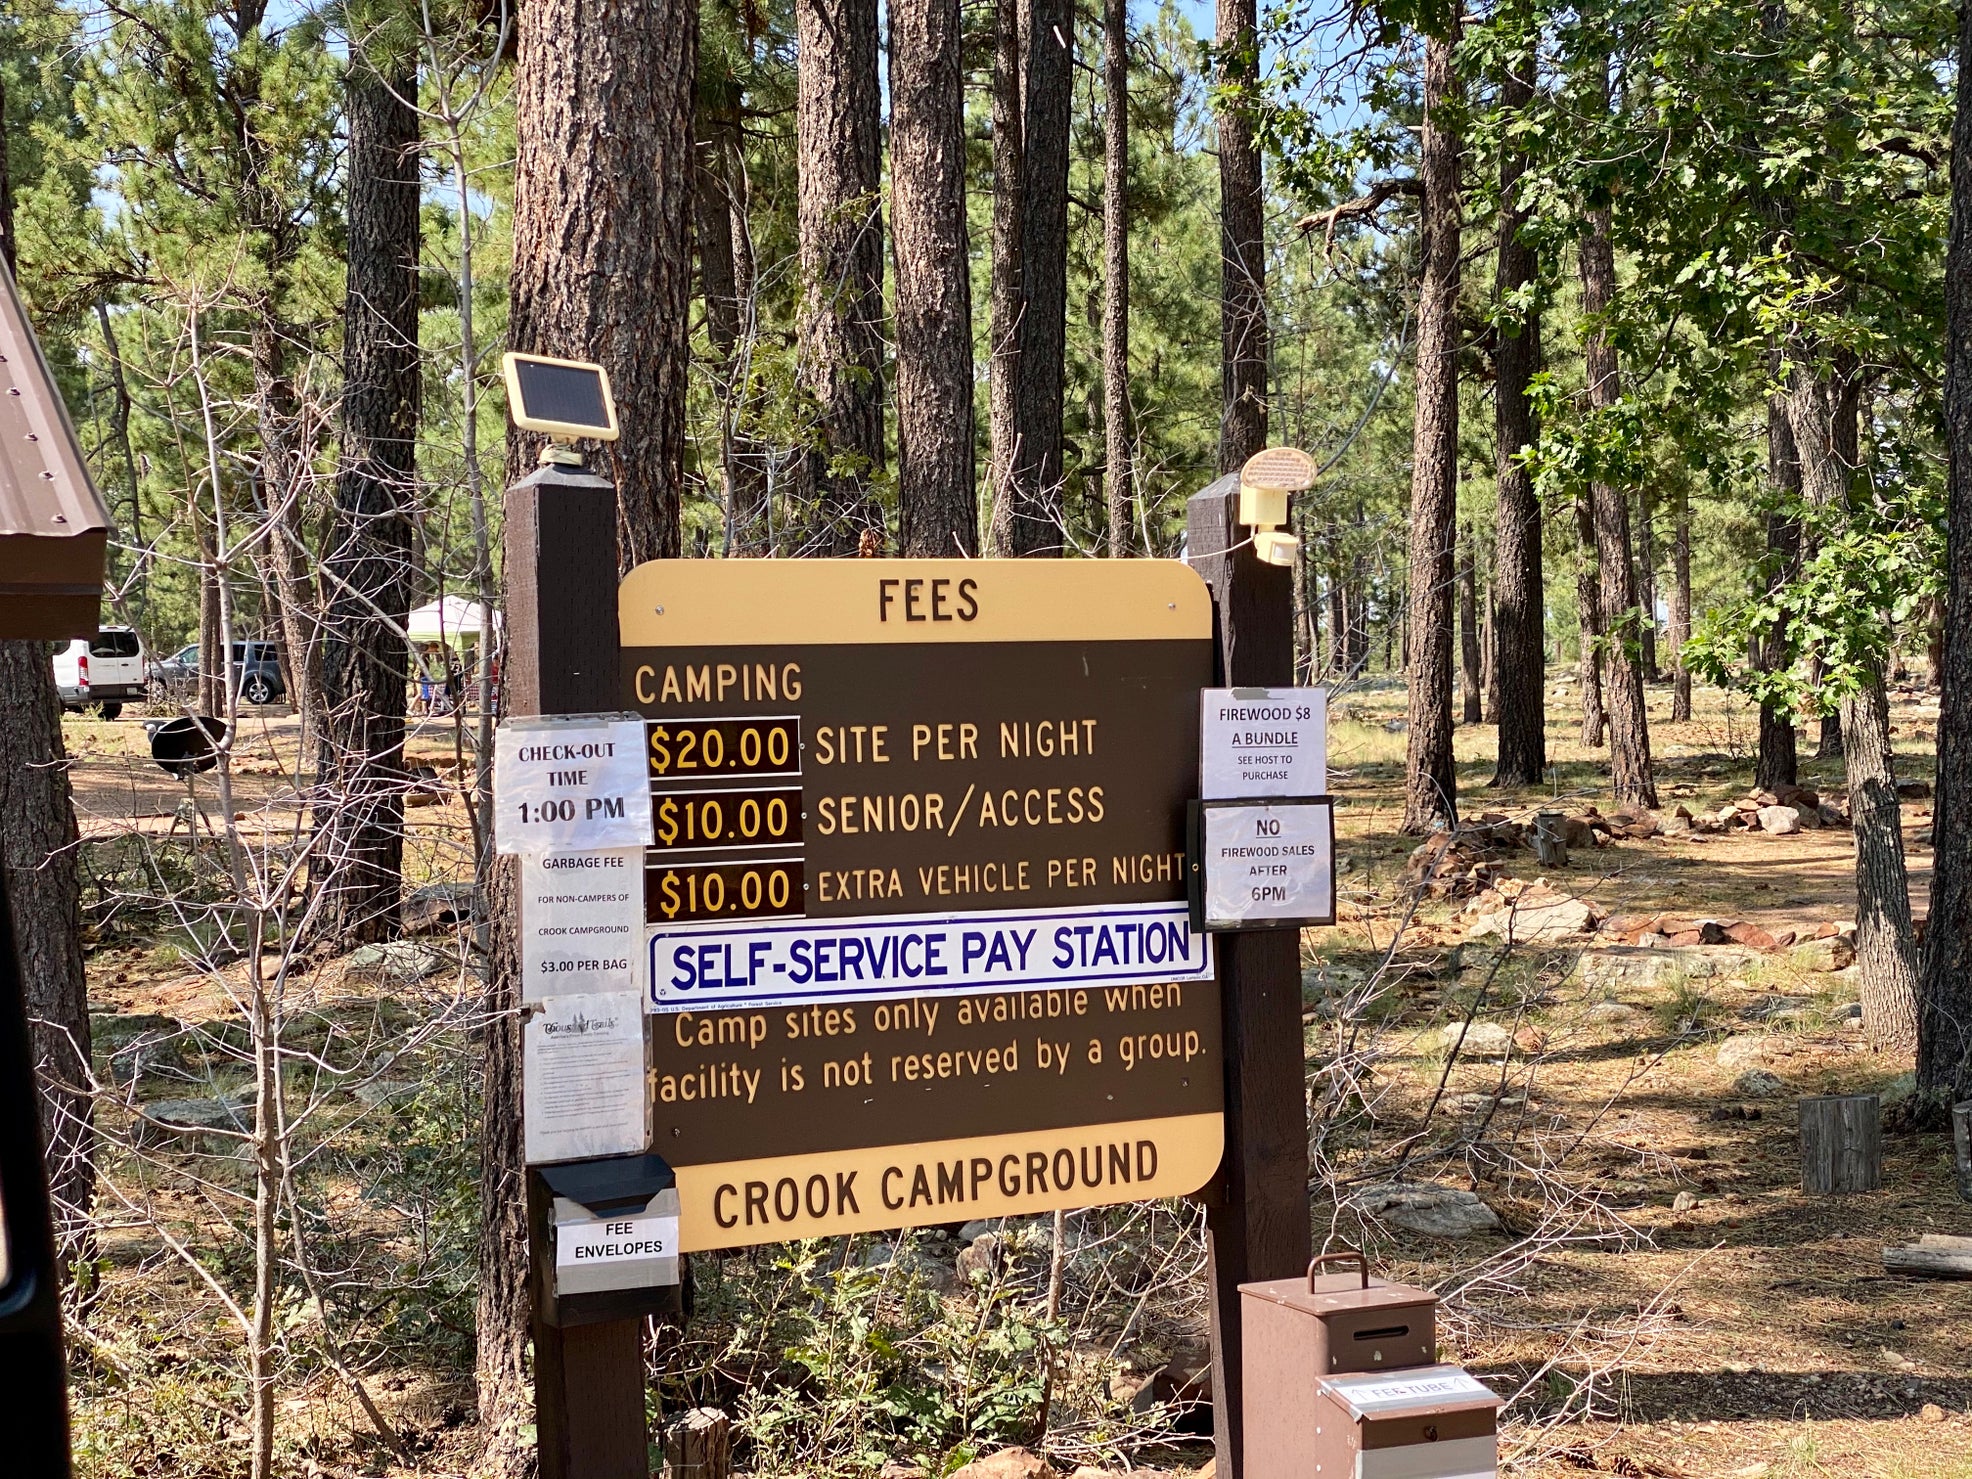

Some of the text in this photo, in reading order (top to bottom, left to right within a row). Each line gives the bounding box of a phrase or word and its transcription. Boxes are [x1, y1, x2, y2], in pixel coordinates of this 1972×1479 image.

[879, 578, 979, 622] FEES
[635, 662, 803, 704] CAMPING
[1219, 705, 1311, 722] FIREWOOD $8
[1232, 731, 1298, 745] A BUNDLE
[518, 742, 616, 762] CHECK-OUT
[649, 719, 1098, 775] $20.00 SITE PER NIGHT
[1238, 755, 1293, 765] SEE HOST TO
[547, 770, 588, 787] TIME
[1242, 771, 1288, 780] PURCHASE
[518, 797, 625, 824] 1:00 PM
[657, 783, 1105, 846] $10.00 SENIOR/ACCESS
[1256, 819, 1280, 836] NO
[1221, 845, 1315, 858] FIREWOOD SALES
[542, 856, 624, 869] GARBAGE FEE
[1249, 865, 1287, 876] AFTER
[659, 852, 1186, 919] $10.00 EXTRA VEHICLE PER NIGHT
[1251, 886, 1286, 901] 6PM
[538, 893, 630, 904] FOR NON-CAMPERS OF
[538, 925, 629, 936] CROOK CAMPGROUND
[671, 920, 1190, 991] SELF-SERVICE PAY STATION
[541, 959, 627, 974] $3.00 PER BAG
[674, 983, 1182, 1049] Camp sites only available when
[681, 1004, 709, 1012] Department
[781, 1057, 805, 1092] is
[823, 1051, 873, 1088] not
[891, 1039, 1019, 1082] reserved
[1037, 1036, 1071, 1076] by
[1088, 1038, 1103, 1065] a
[1119, 1029, 1206, 1072] group.
[714, 1139, 1159, 1229] CROOK CAMPGROUND
[606, 1222, 633, 1236] FEE
[575, 1240, 663, 1258] ENVELOPES
[1371, 1382, 1451, 1399] FEE TUBE
